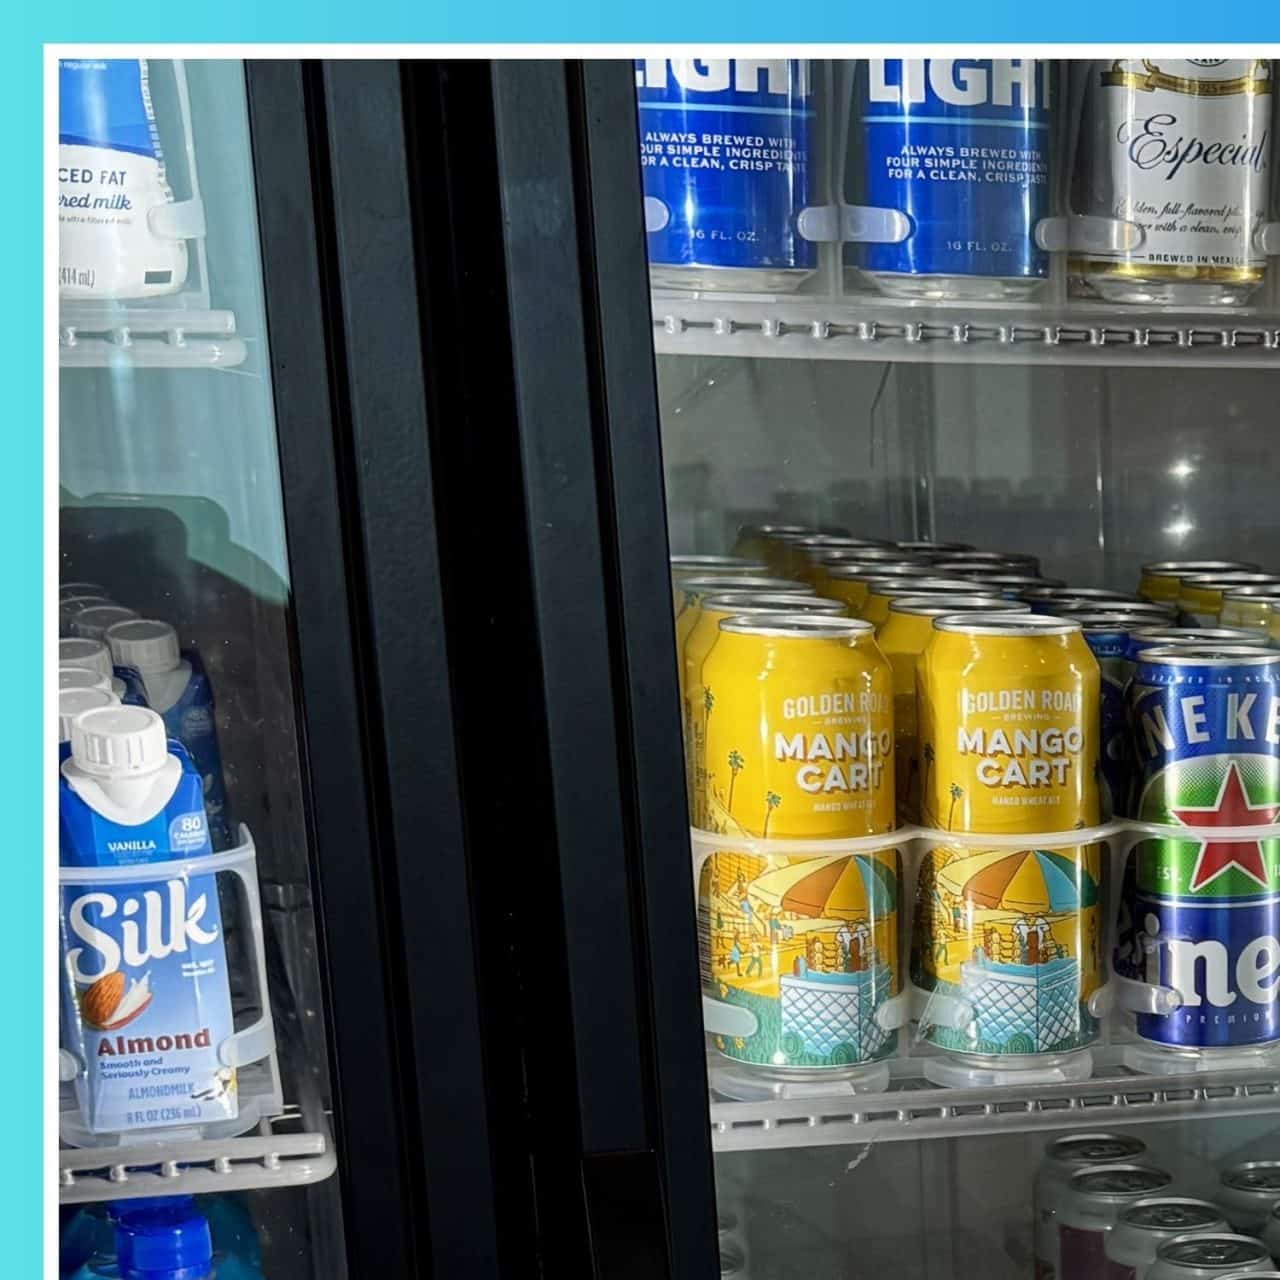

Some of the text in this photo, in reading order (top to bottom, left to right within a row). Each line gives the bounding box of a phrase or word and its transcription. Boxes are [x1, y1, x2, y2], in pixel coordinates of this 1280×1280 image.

[637, 59, 813, 97] IGH
[646, 131, 697, 143] ALWAYS
[702, 134, 764, 147] BREWED
[1117, 114, 1267, 180] Especial
[641, 143, 721, 157] OUR SIMPLE
[901, 145, 955, 157] ALWAYS
[960, 147, 1017, 160] BREWED
[641, 156, 773, 172] OR A CLEAN, CRISP
[886, 156, 977, 169] FOUR SIMPLE
[99, 169, 127, 186] FAT
[889, 168, 1024, 183] FOR A CLEAN, CRISP
[92, 193, 133, 211] milk
[711, 230, 732, 240] FL.
[737, 232, 760, 242] OZ.
[946, 241, 1013, 252] 16 FL. OZ.
[1149, 255, 1193, 264] BREWED
[1198, 256, 1208, 264] IN
[783, 692, 854, 720] GOLDEN
[966, 689, 1081, 714] GOLDEN ROAD
[774, 728, 891, 762] MANGO
[957, 725, 1084, 757] MANGO
[796, 761, 883, 794] CART
[975, 758, 1071, 788] CART
[181, 815, 201, 832] 80
[107, 839, 157, 852] VANILLA
[65, 879, 219, 984] Silk
[97, 1028, 211, 1057] Almond
[100, 1056, 163, 1070] Smooth and
[101, 1064, 191, 1080] Seriously Creamy
[128, 1082, 194, 1101] ALMONDMILK
[134, 1110, 144, 1124] FL
[145, 1109, 159, 1123] OZ
